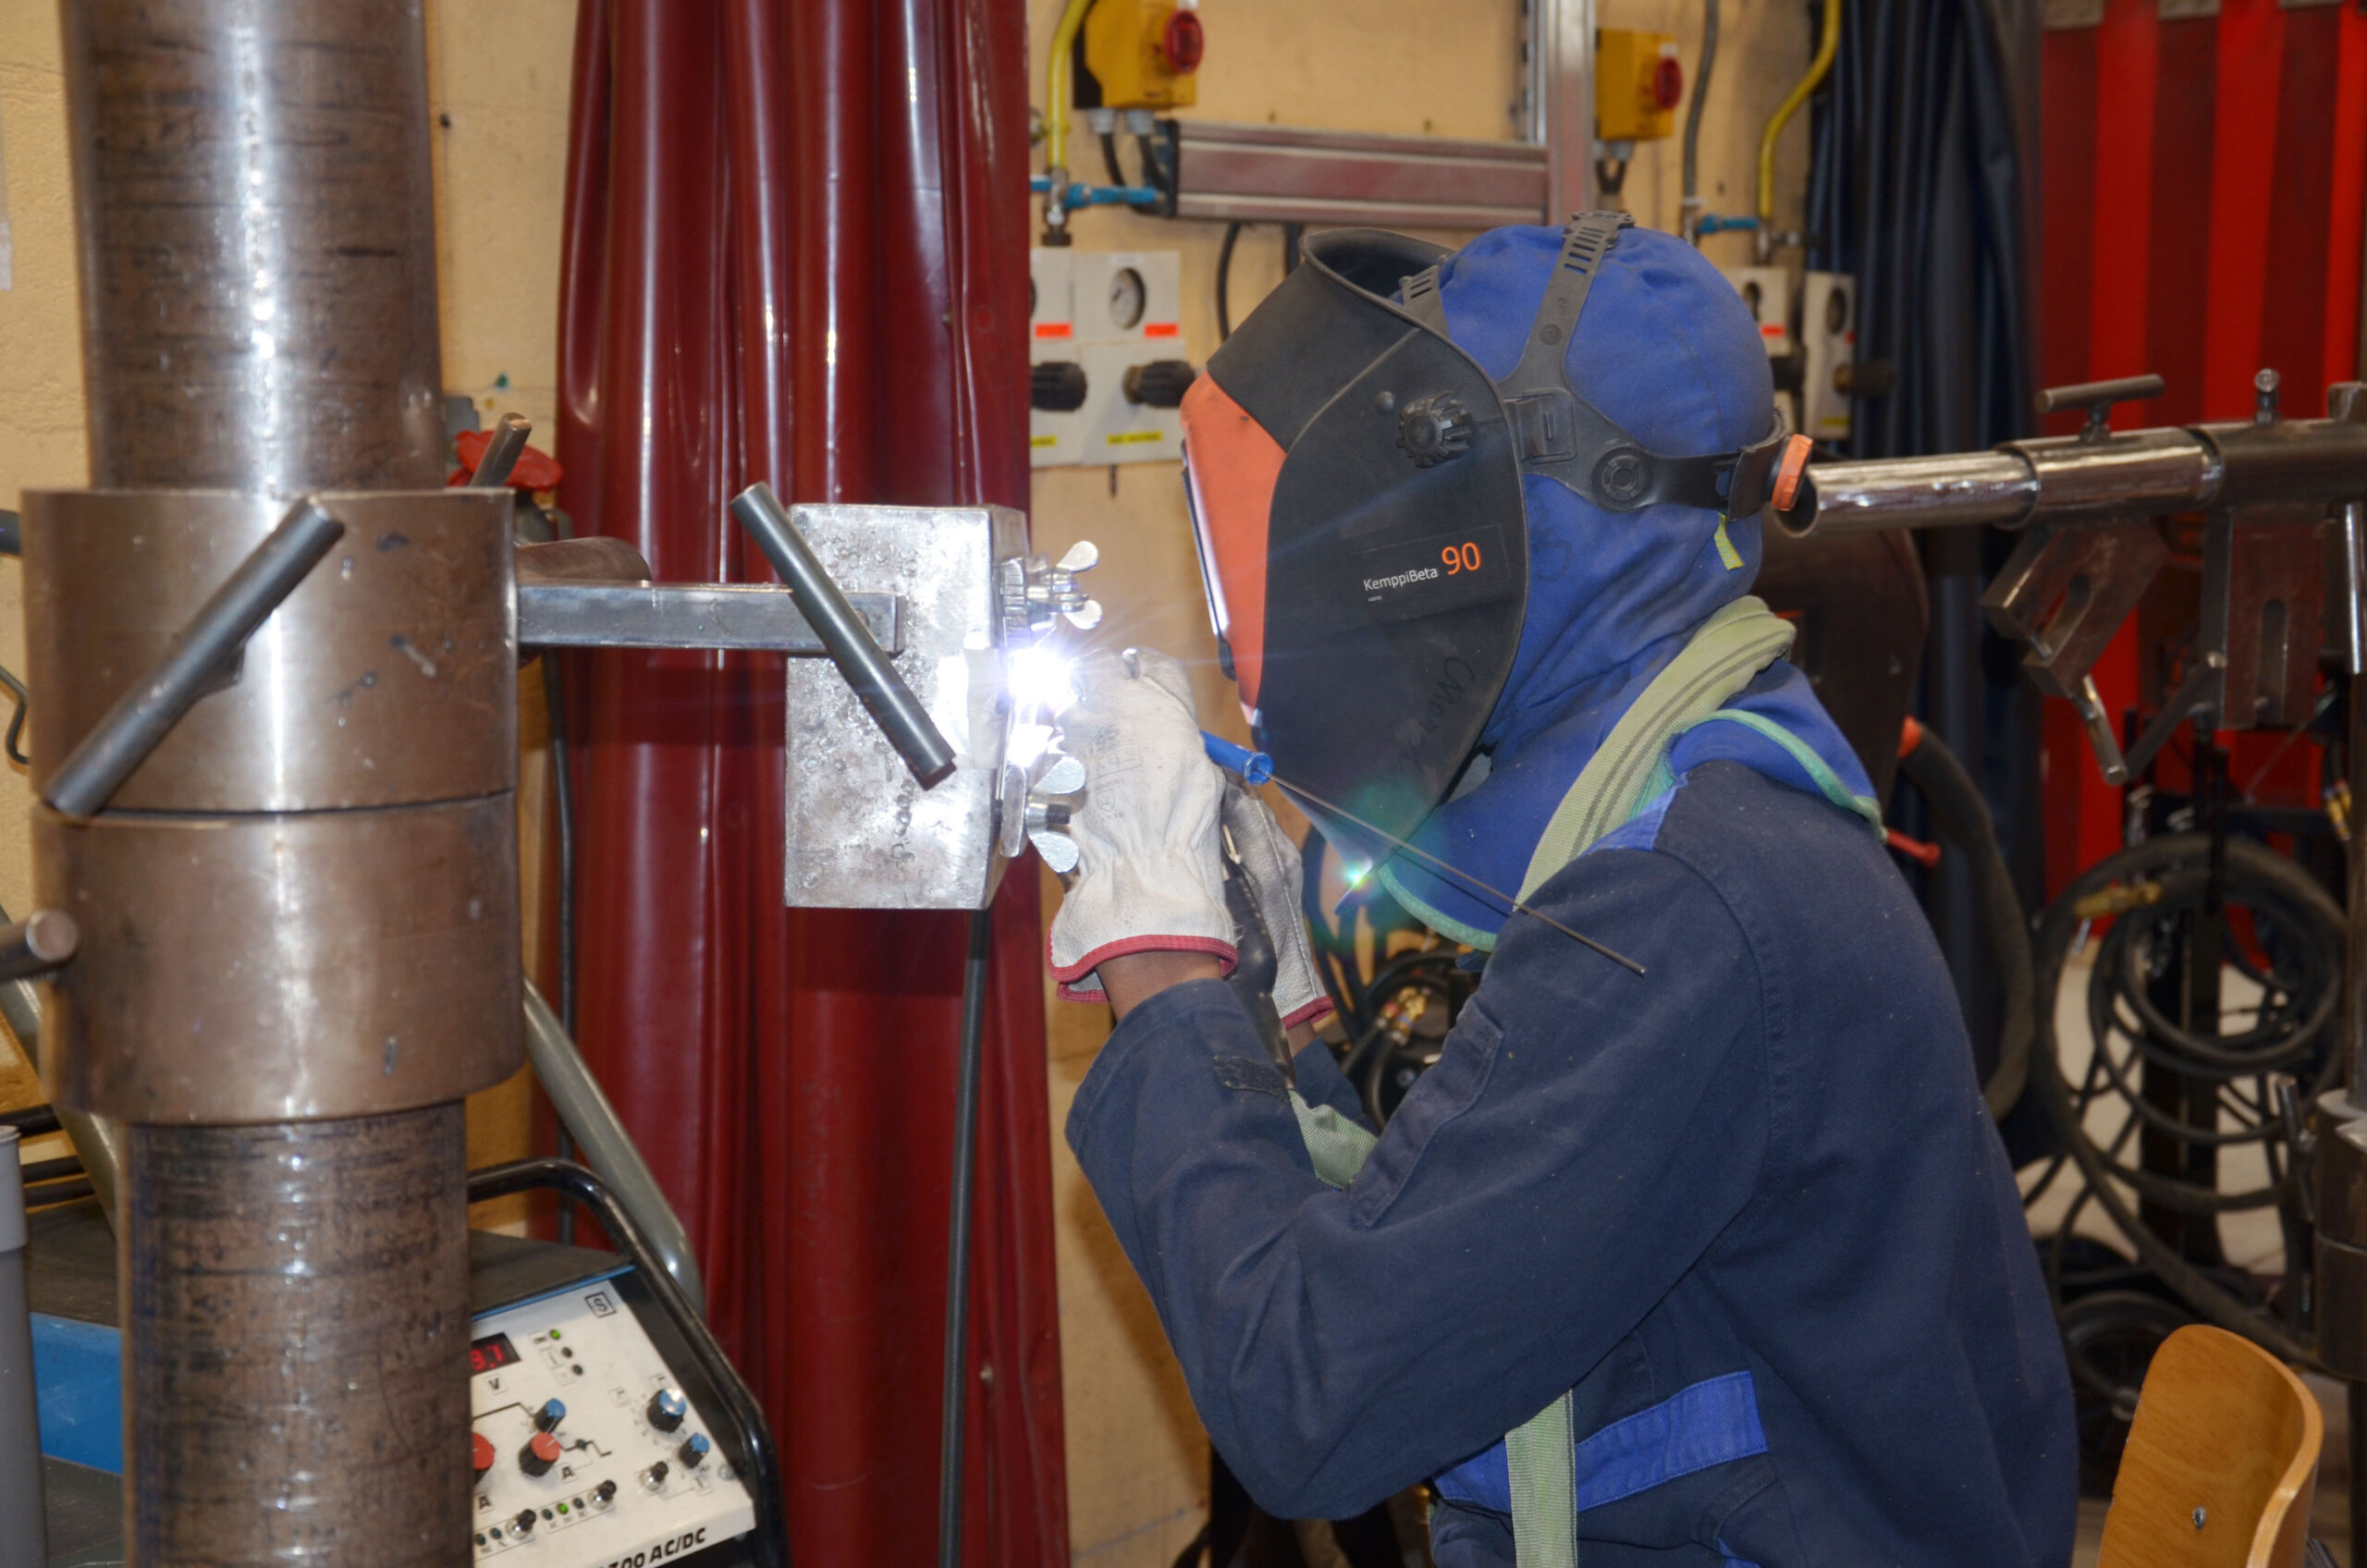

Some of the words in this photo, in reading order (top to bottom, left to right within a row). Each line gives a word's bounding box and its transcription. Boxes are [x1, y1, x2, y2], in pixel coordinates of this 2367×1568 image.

[1363, 567, 1438, 591] KemppiBeta
[1441, 542, 1481, 575] 90
[488, 1378, 499, 1390] V
[561, 1466, 574, 1479] A
[478, 1495, 491, 1510] A
[649, 1526, 706, 1563] AC/DC
